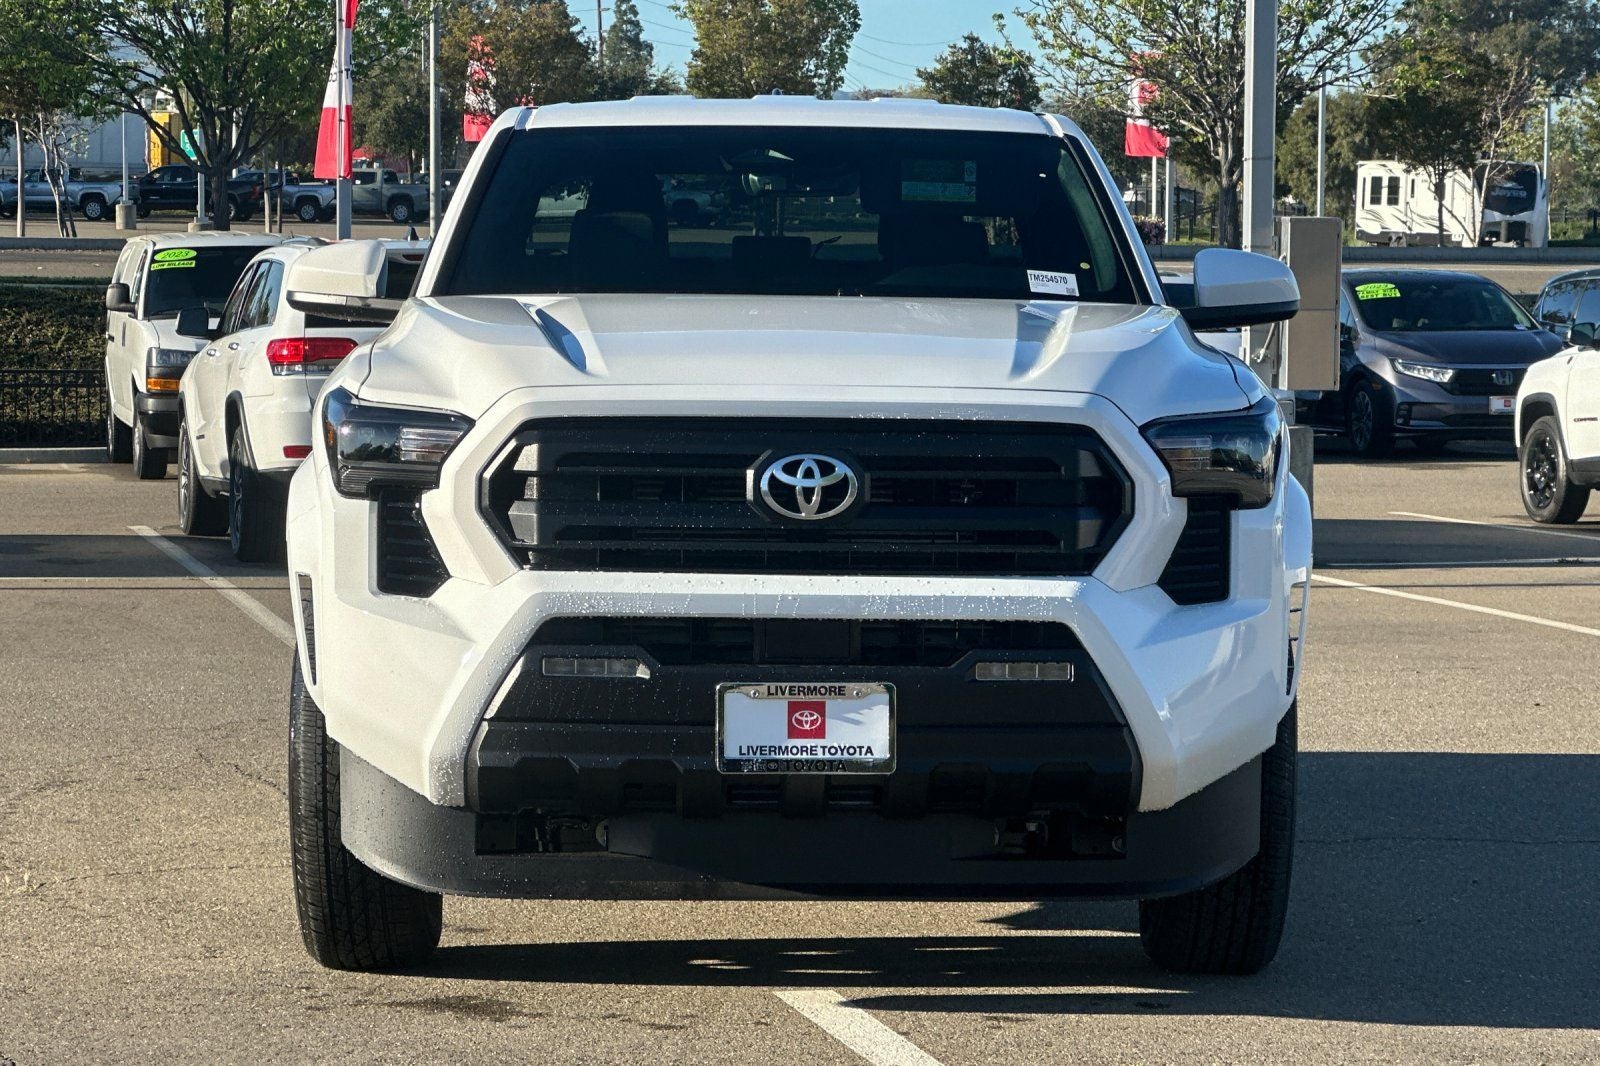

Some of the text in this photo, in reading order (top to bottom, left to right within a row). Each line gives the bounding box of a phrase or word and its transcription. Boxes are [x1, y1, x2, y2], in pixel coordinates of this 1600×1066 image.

[1029, 274, 1068, 284] TM254570
[766, 685, 847, 697] LIVERMORE
[738, 745, 874, 756] LIVERMORE TOYOTA
[781, 759, 847, 772] TOYOTA
